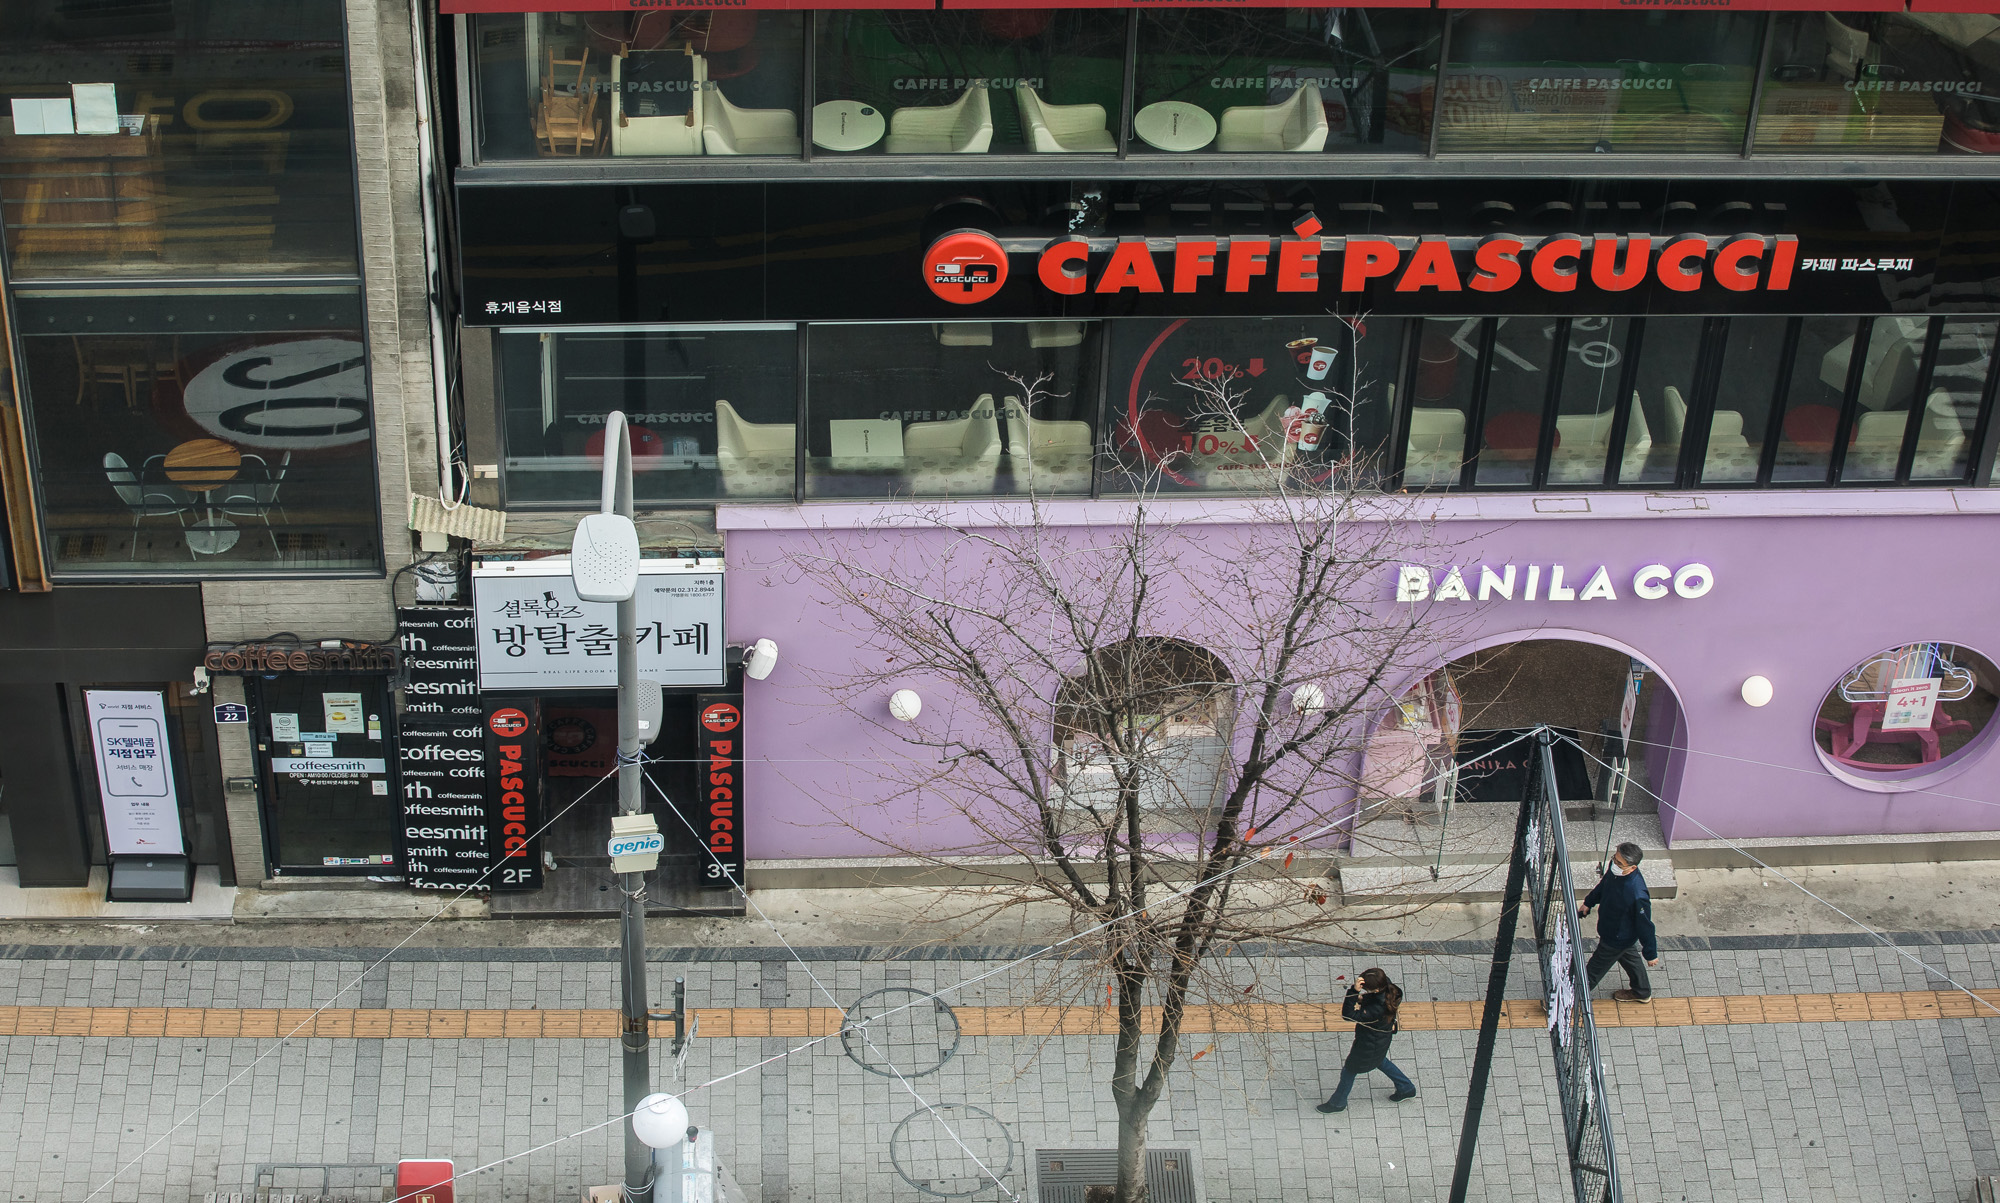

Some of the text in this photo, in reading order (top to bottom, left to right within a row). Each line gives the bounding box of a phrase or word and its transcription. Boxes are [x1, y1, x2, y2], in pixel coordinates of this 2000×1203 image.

[566, 81, 718, 93] CAFFE PASCUCCI
[893, 78, 1045, 90] CAFFE PASCUCCI
[1211, 77, 1359, 89] CAFFE PASCUCCI
[1529, 79, 1673, 90] CAFFE PASCUCCI
[1843, 80, 1982, 93] CAFFE PASCUCCI
[1340, 233, 1799, 293] PASCUCCI
[1801, 258, 1914, 271] 카페 파스쿠찌
[485, 300, 563, 314] 휴게음식점
[1182, 357, 1244, 380] 20%
[879, 409, 1021, 421] CAFFE PASCUCCI
[1395, 562, 1714, 602] BANILA CO
[204, 645, 397, 671] coffeesmith
[1896, 695, 1928, 708] 4+1
[224, 713, 239, 721] 22
[402, 730, 448, 738] coffeesmith
[106, 737, 155, 747] SK텔레콤
[109, 749, 156, 759] 지점 업무
[289, 761, 366, 771] coffeesmith
[404, 781, 433, 799] th
[709, 740, 733, 853] PASCUCCI
[499, 744, 527, 857] PASCUCCI
[407, 846, 448, 857] smith
[613, 836, 661, 855] genie
[503, 868, 532, 883] 2F
[707, 863, 737, 879] 3F
